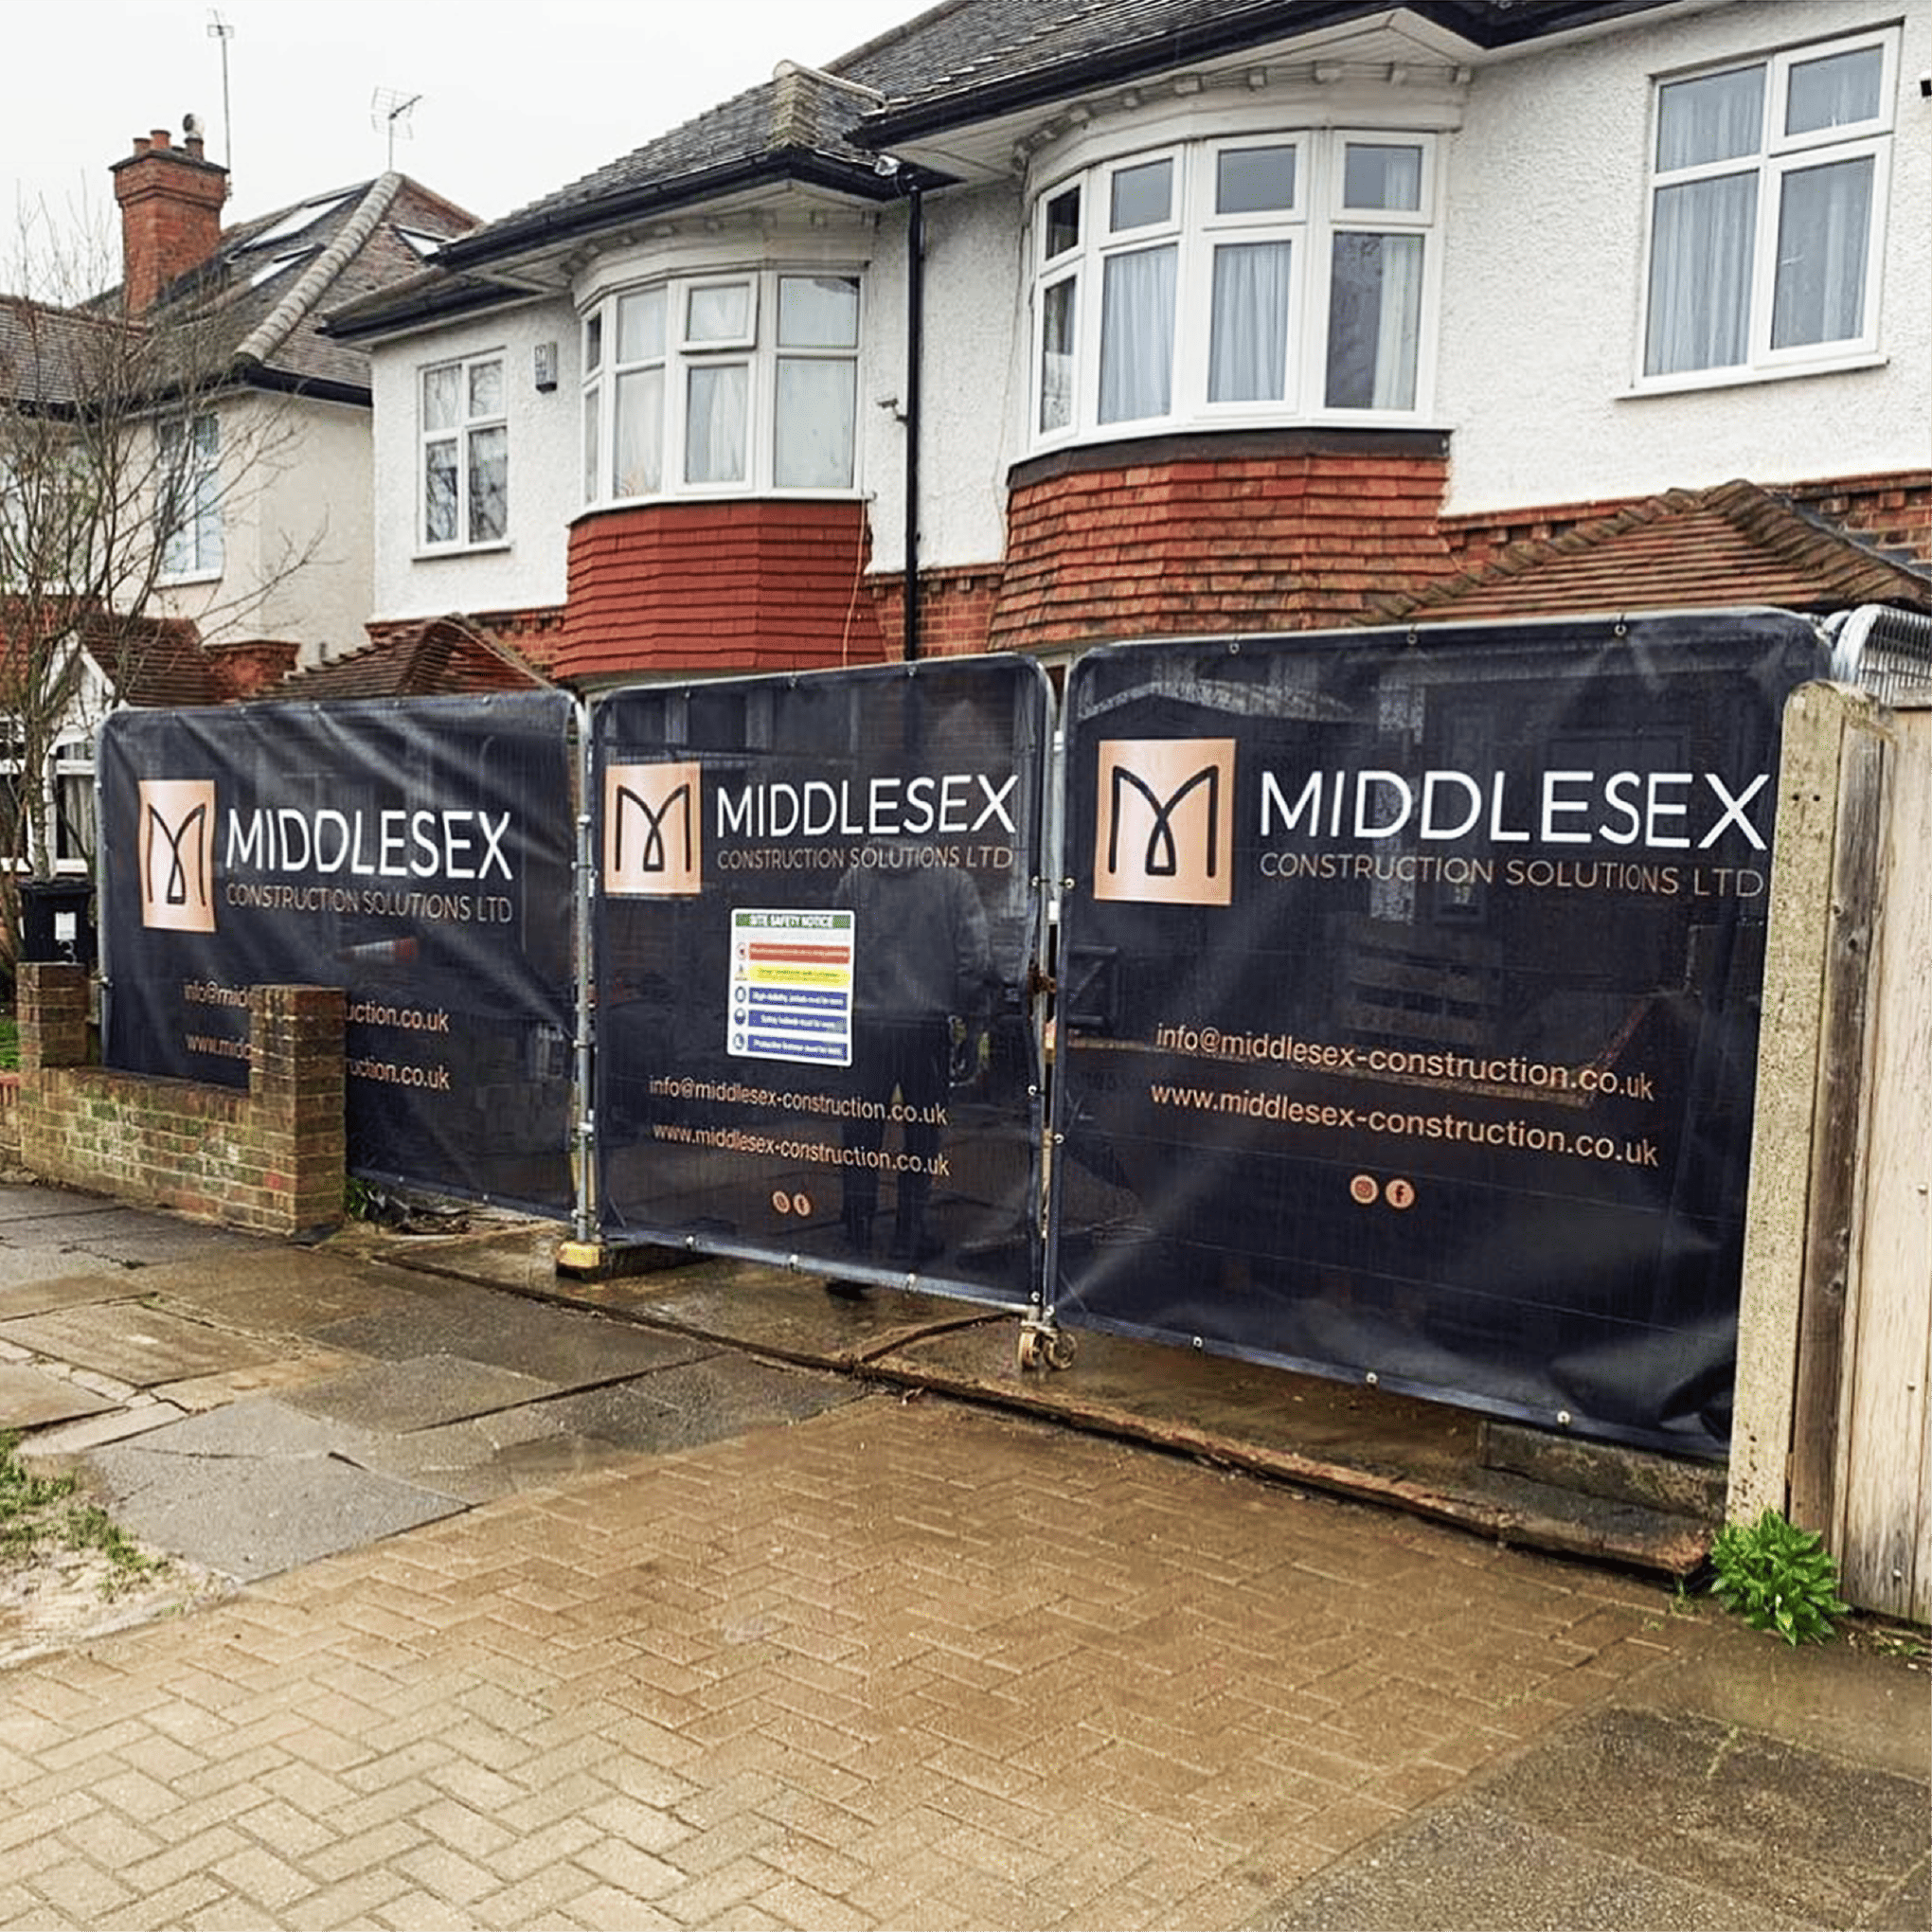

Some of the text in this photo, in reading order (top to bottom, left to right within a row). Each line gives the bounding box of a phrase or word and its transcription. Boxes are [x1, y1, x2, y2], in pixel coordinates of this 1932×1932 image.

[717, 774, 1019, 838] MIDDLESEX
[1260, 770, 1770, 851] MIDDLESEX
[225, 808, 513, 881] MIDDLESEX
[717, 846, 1014, 869] CONSTRUCTION SOLUTIONS LTD
[226, 882, 512, 923] CONSTRUCTION SOLUTIONS LTD
[1259, 852, 1765, 899] CONSTRUCTION SOLUTIONS LTD
[1155, 1023, 1655, 1102] info@middlesex-construction.co.uk
[650, 1074, 947, 1125] info@middlesex-construction.co.uk
[1150, 1082, 1660, 1168] www.middlesex-construction.co.uk
[652, 1122, 950, 1175] www.middlesex-construction.co.uk
